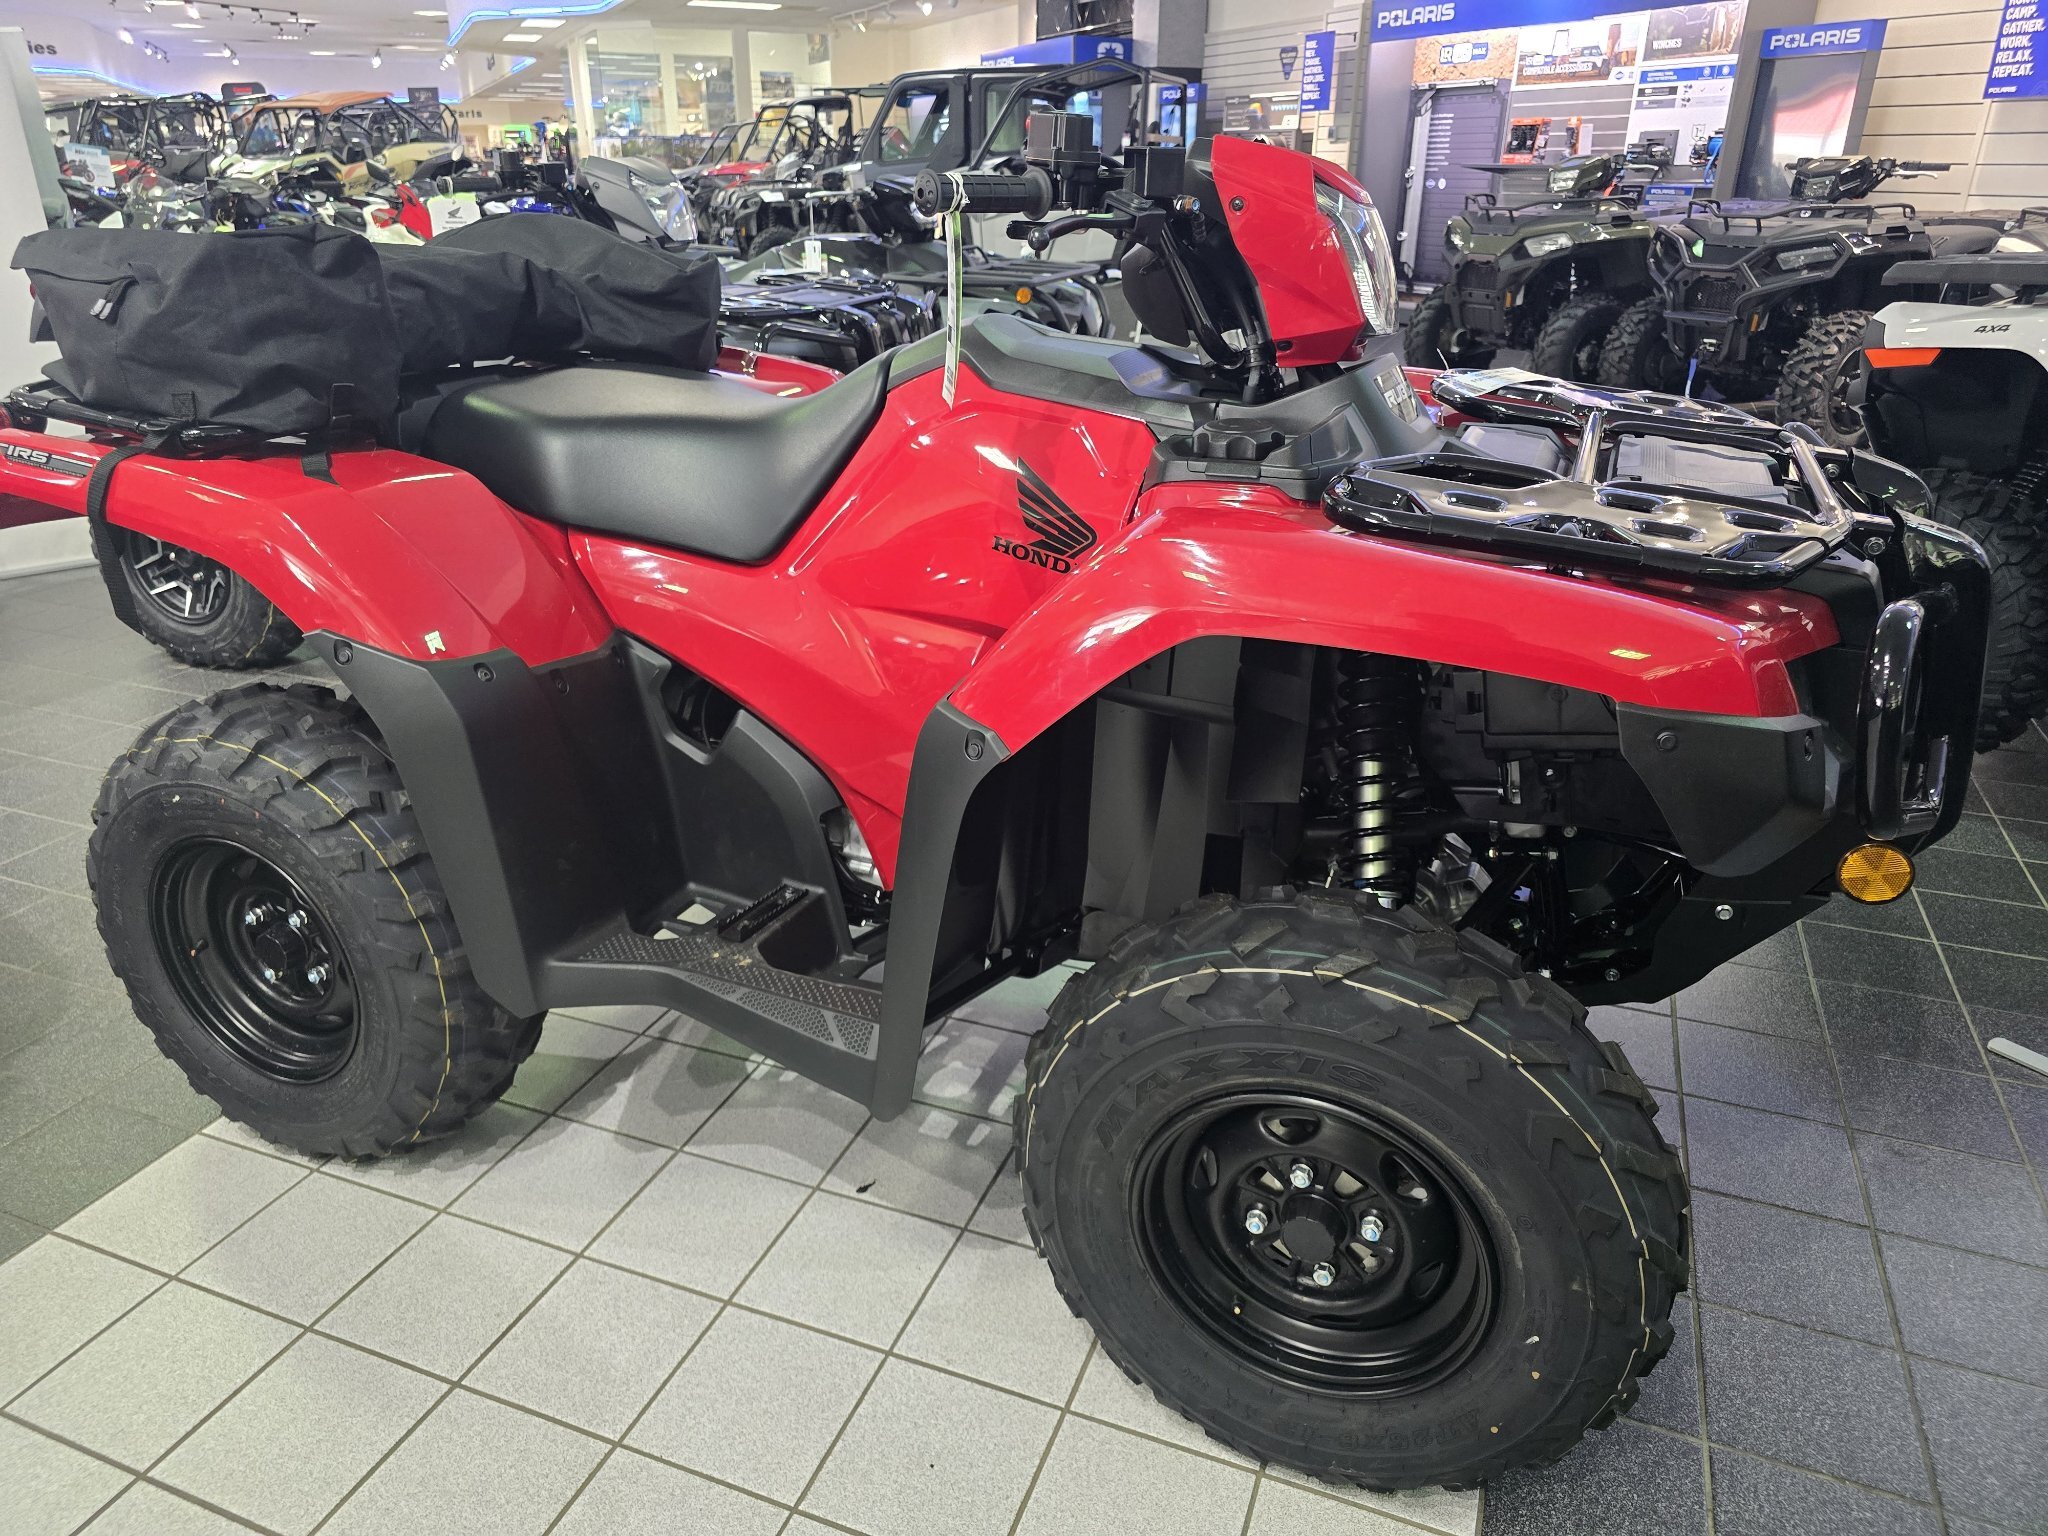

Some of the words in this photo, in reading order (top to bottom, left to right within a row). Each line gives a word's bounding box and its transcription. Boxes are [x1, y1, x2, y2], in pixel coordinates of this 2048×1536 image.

[1377, 3, 1456, 29] POLARIS
[2006, 5, 2039, 20] CAMP.
[2002, 18, 2046, 35] GATHER.
[1652, 39, 1682, 50] WINCHES
[1769, 27, 1862, 51] POLARIS
[2000, 34, 2032, 50] WORK.
[1996, 48, 2034, 64] RELAX.
[1992, 62, 2034, 79] REPEAT.
[7, 444, 49, 464] IRS
[992, 535, 1073, 574] HOND
[1093, 1049, 1389, 1152] MAXXIS
